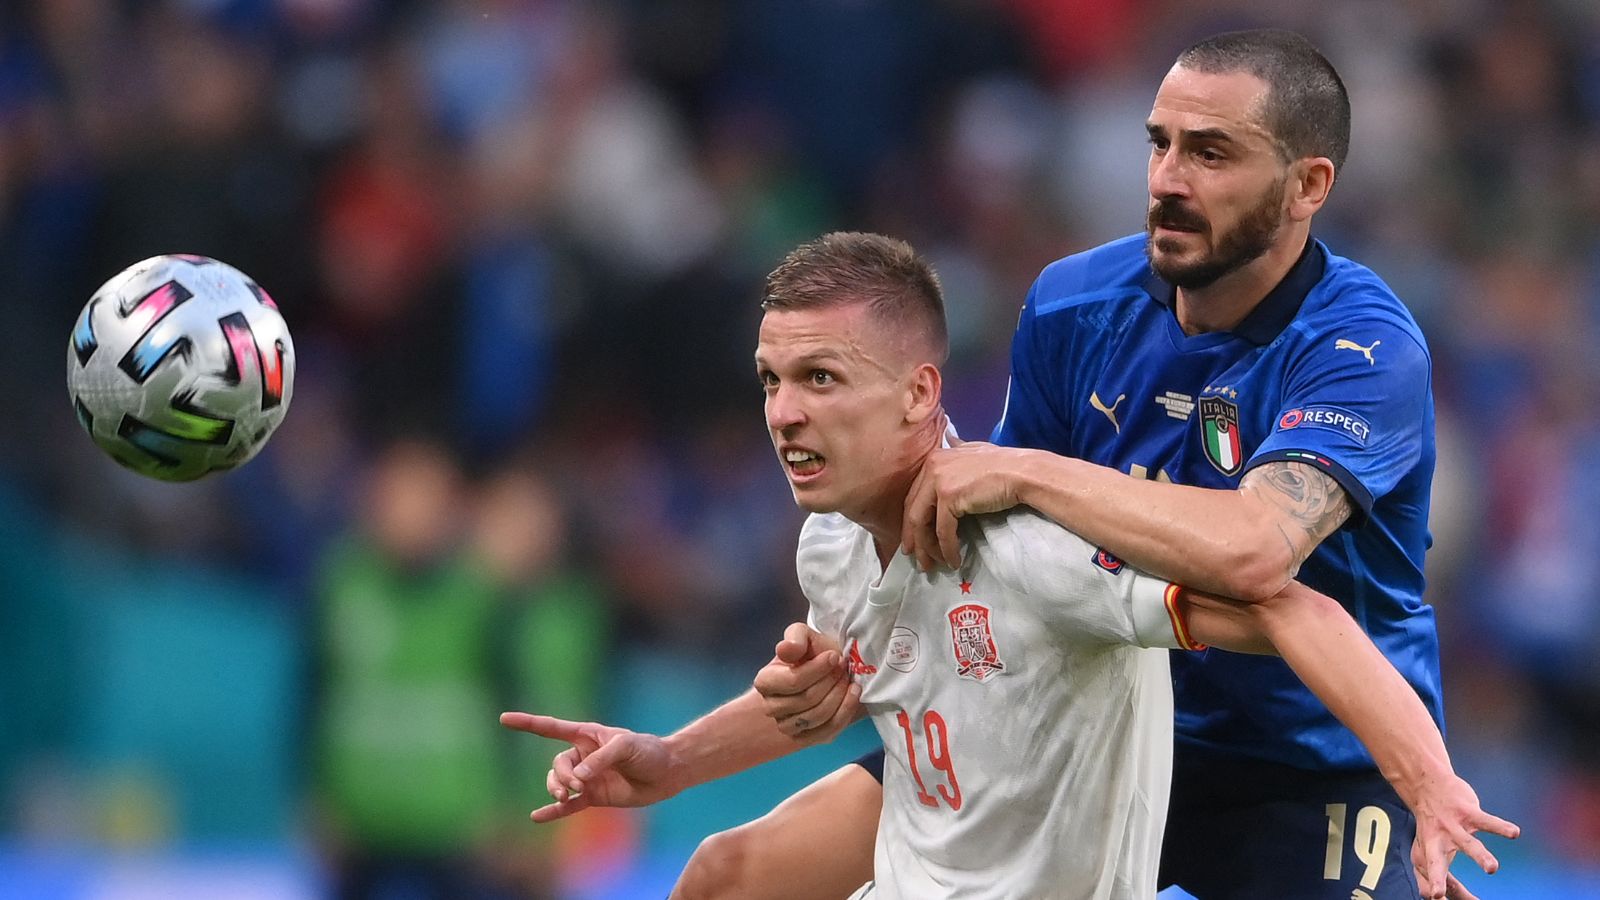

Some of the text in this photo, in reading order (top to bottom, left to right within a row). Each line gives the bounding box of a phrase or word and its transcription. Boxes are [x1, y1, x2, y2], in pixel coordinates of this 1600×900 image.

[1203, 402, 1235, 420] ITALIA
[1303, 411, 1370, 440] RESPECT
[896, 709, 962, 811] 19
[1323, 803, 1391, 891] 19
